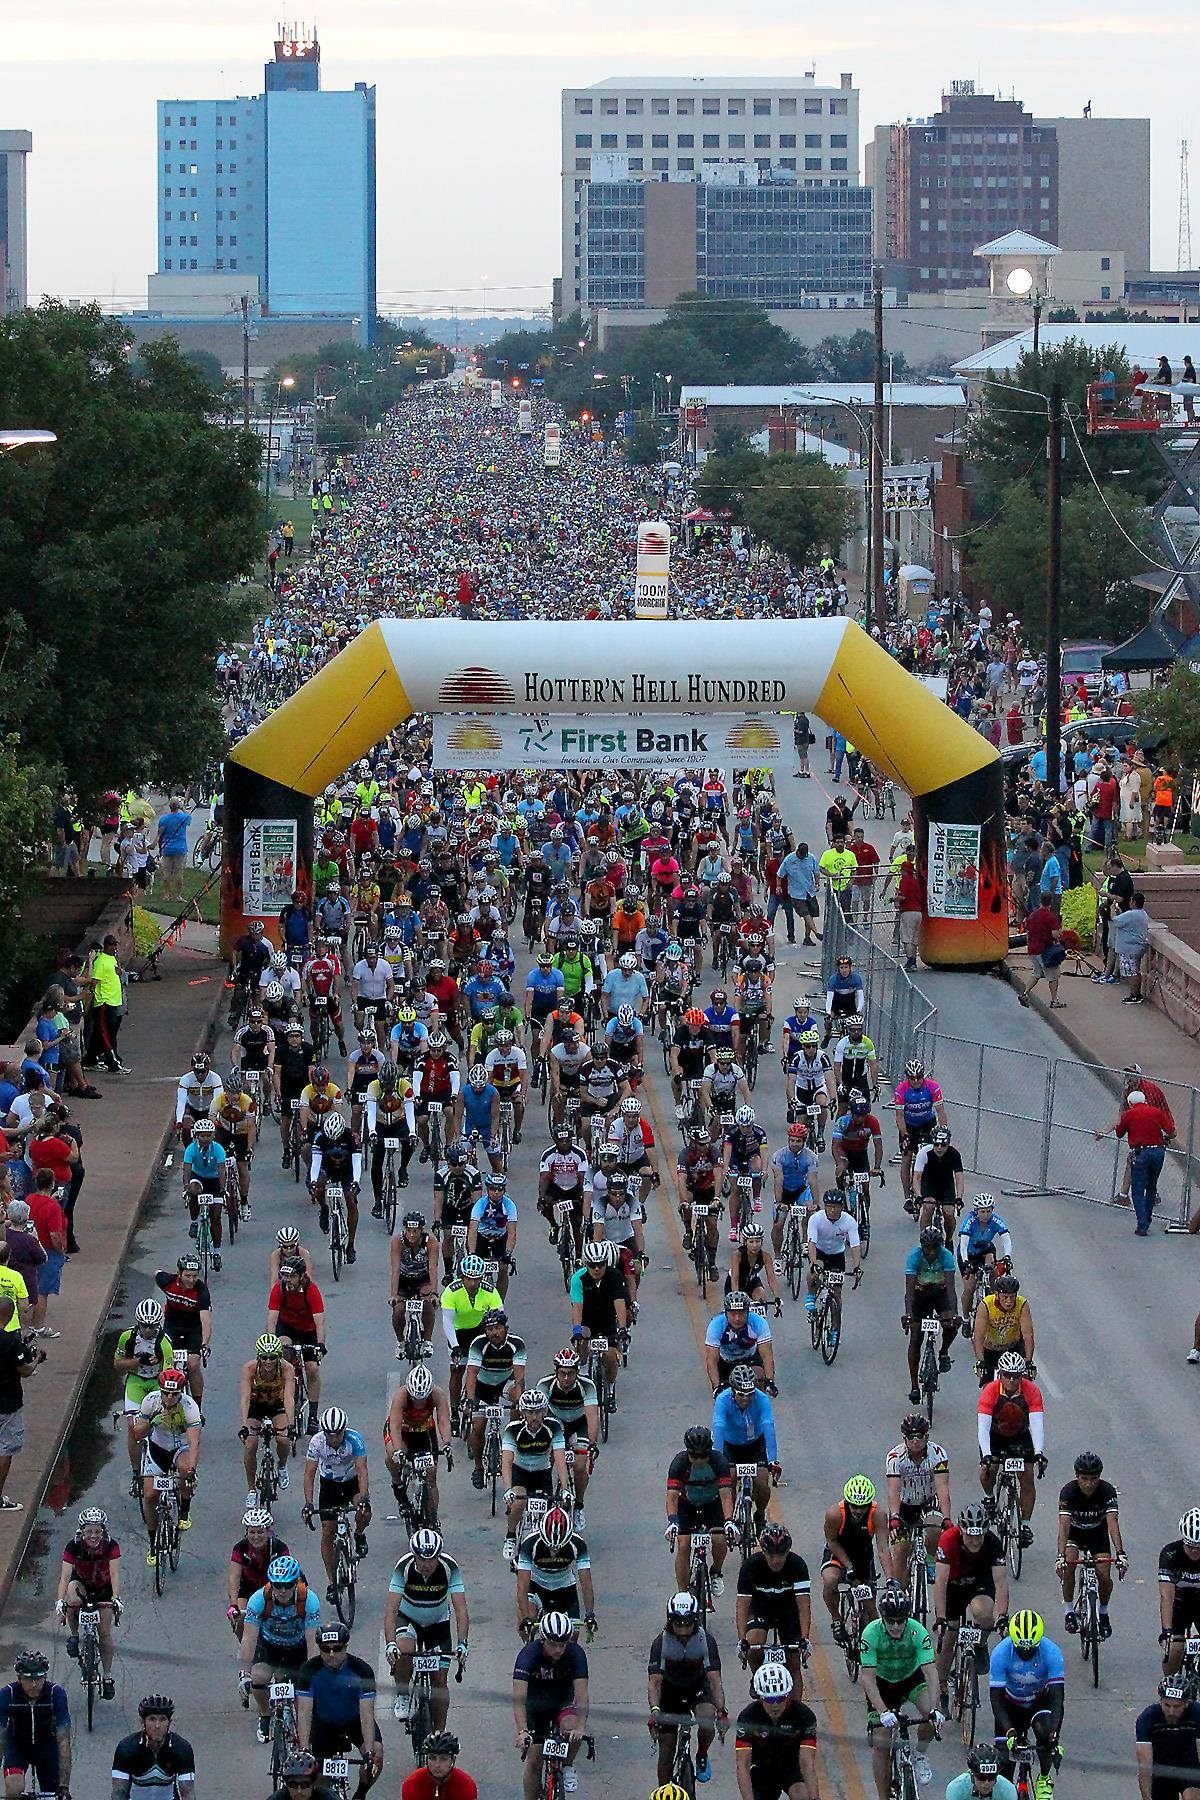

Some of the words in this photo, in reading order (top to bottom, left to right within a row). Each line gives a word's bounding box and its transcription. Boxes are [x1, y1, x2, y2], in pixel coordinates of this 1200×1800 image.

[639, 584, 666, 597] 100M
[524, 672, 626, 703] HOTTER'N
[632, 673, 681, 703] HELL
[687, 673, 786, 703] HUNDRED
[561, 728, 627, 753] First
[636, 728, 709, 753] Bank
[249, 825, 262, 859] Bank
[933, 828, 945, 861] Bank
[248, 862, 261, 893] First
[932, 863, 944, 895] First
[487, 1408, 502, 1418] 8151
[738, 1465, 756, 1476] 6259
[529, 1500, 547, 1511] 5516
[416, 1658, 437, 1670] 5422
[324, 1761, 346, 1774] 9813
